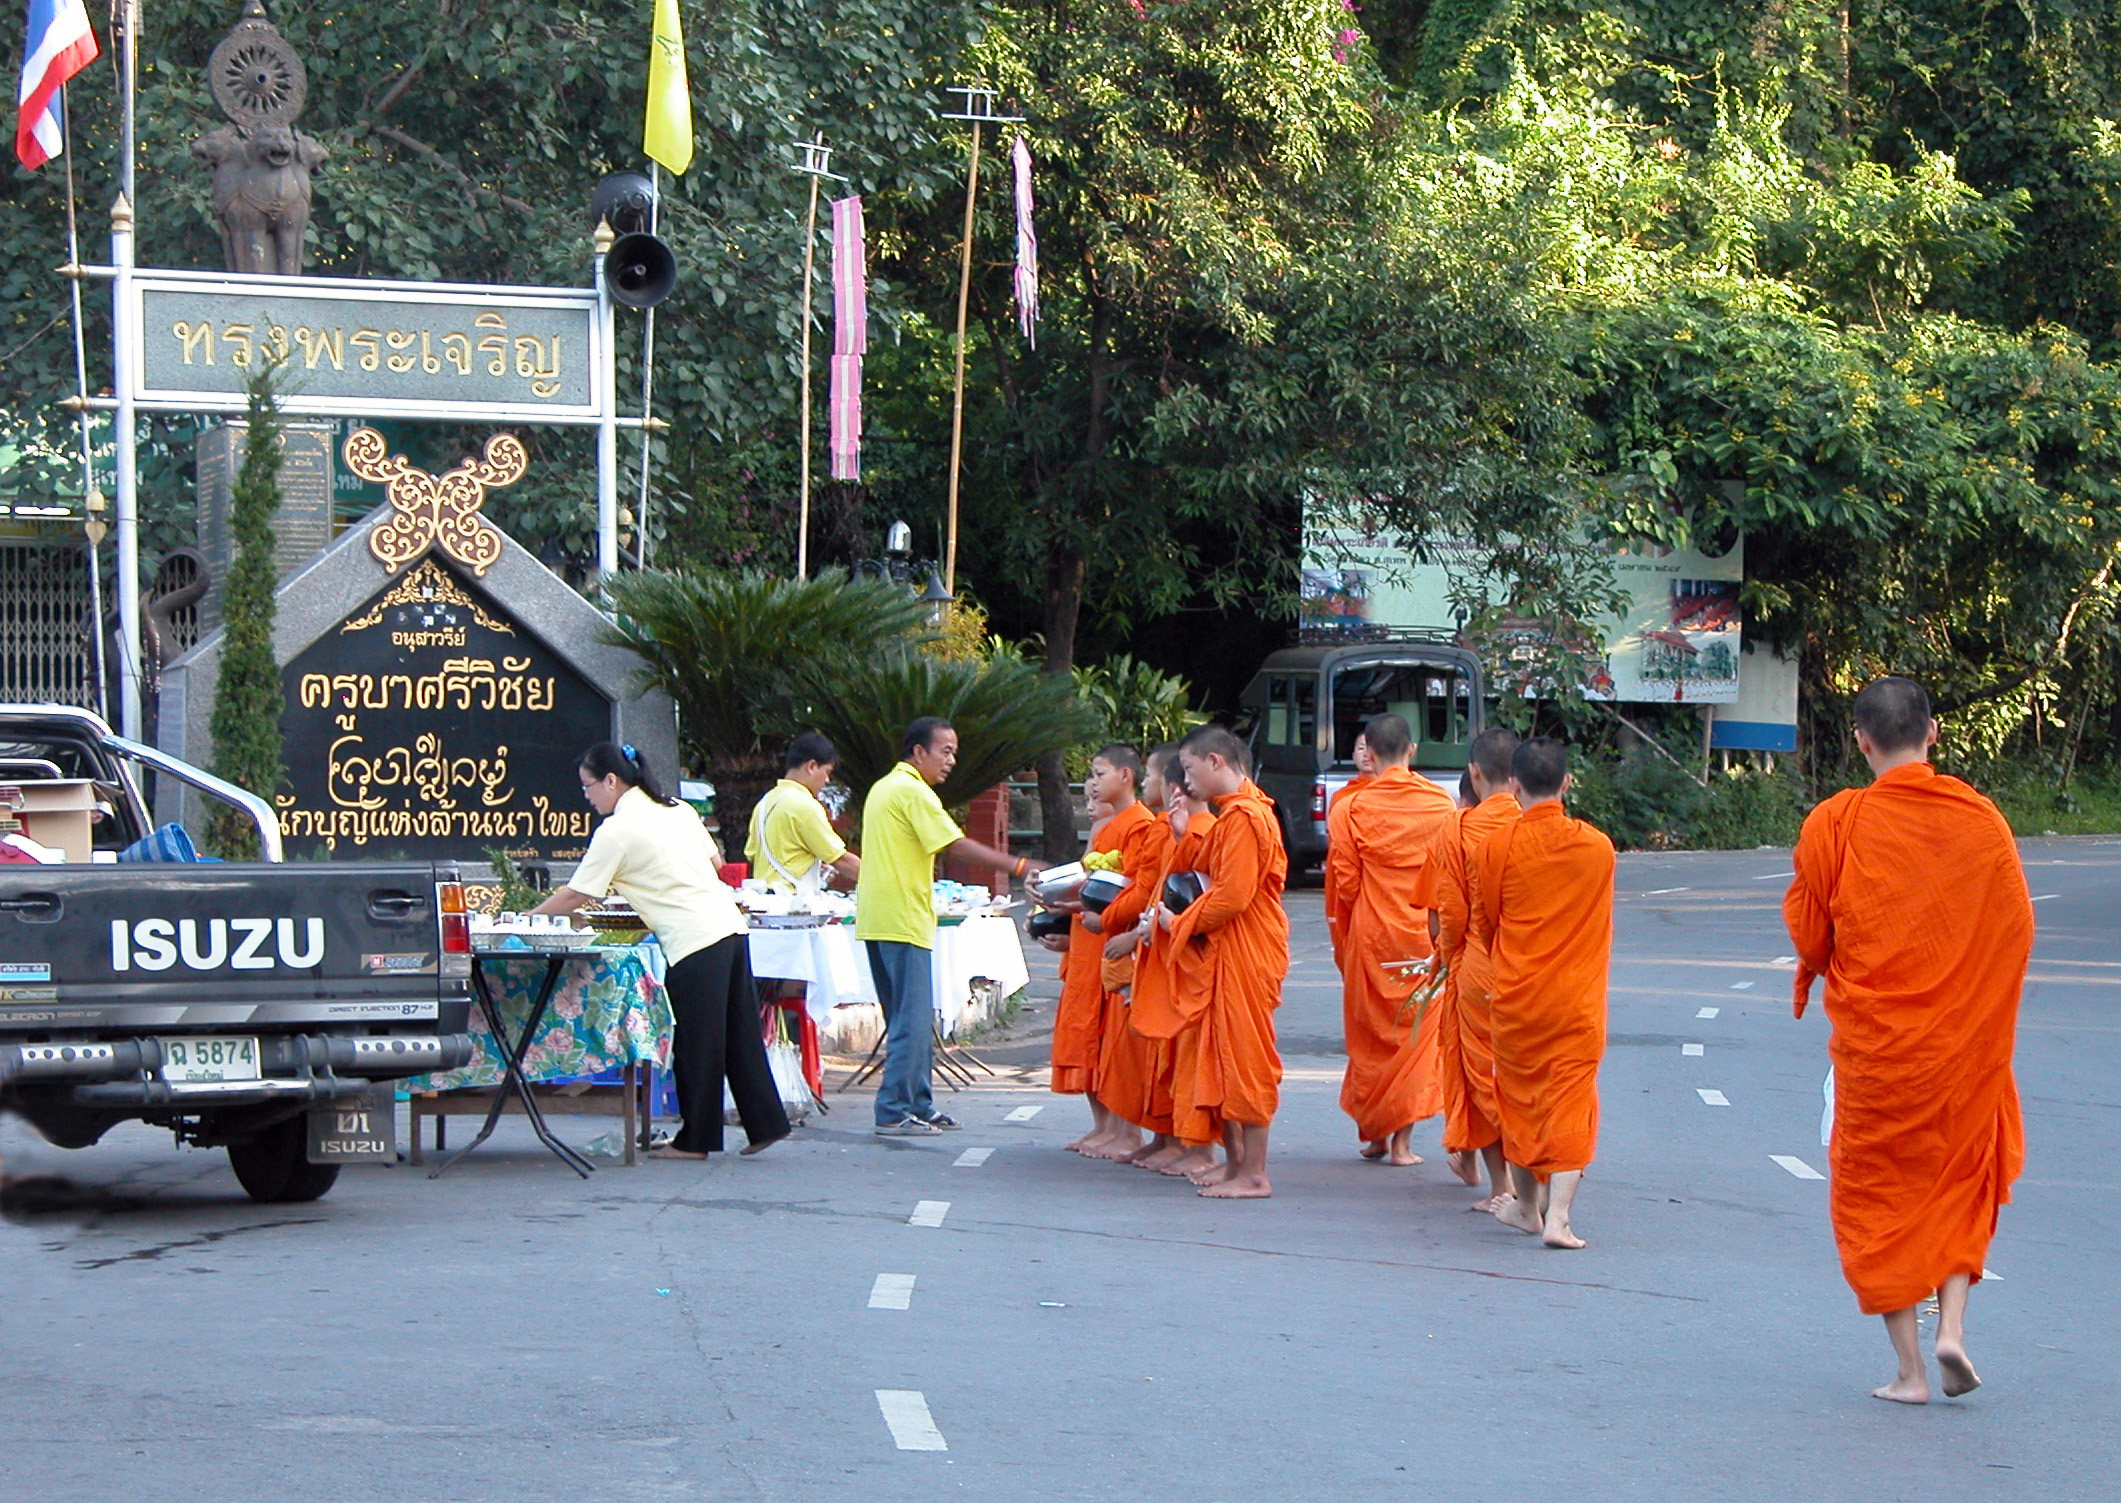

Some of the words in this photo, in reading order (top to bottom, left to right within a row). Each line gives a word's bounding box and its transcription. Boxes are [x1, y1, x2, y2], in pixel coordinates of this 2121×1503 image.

[172, 311, 563, 398] ทรงพระเจริญ
[391, 626, 467, 653] อนุสาวรีย์
[299, 656, 556, 731] ครูบาศรีวิชัย
[110, 917, 326, 972] ISUZU
[401, 1004, 419, 1015] 87
[163, 1042, 188, 1065] ฉ
[195, 1040, 253, 1065] 5874
[320, 1140, 385, 1153] ISUZU
